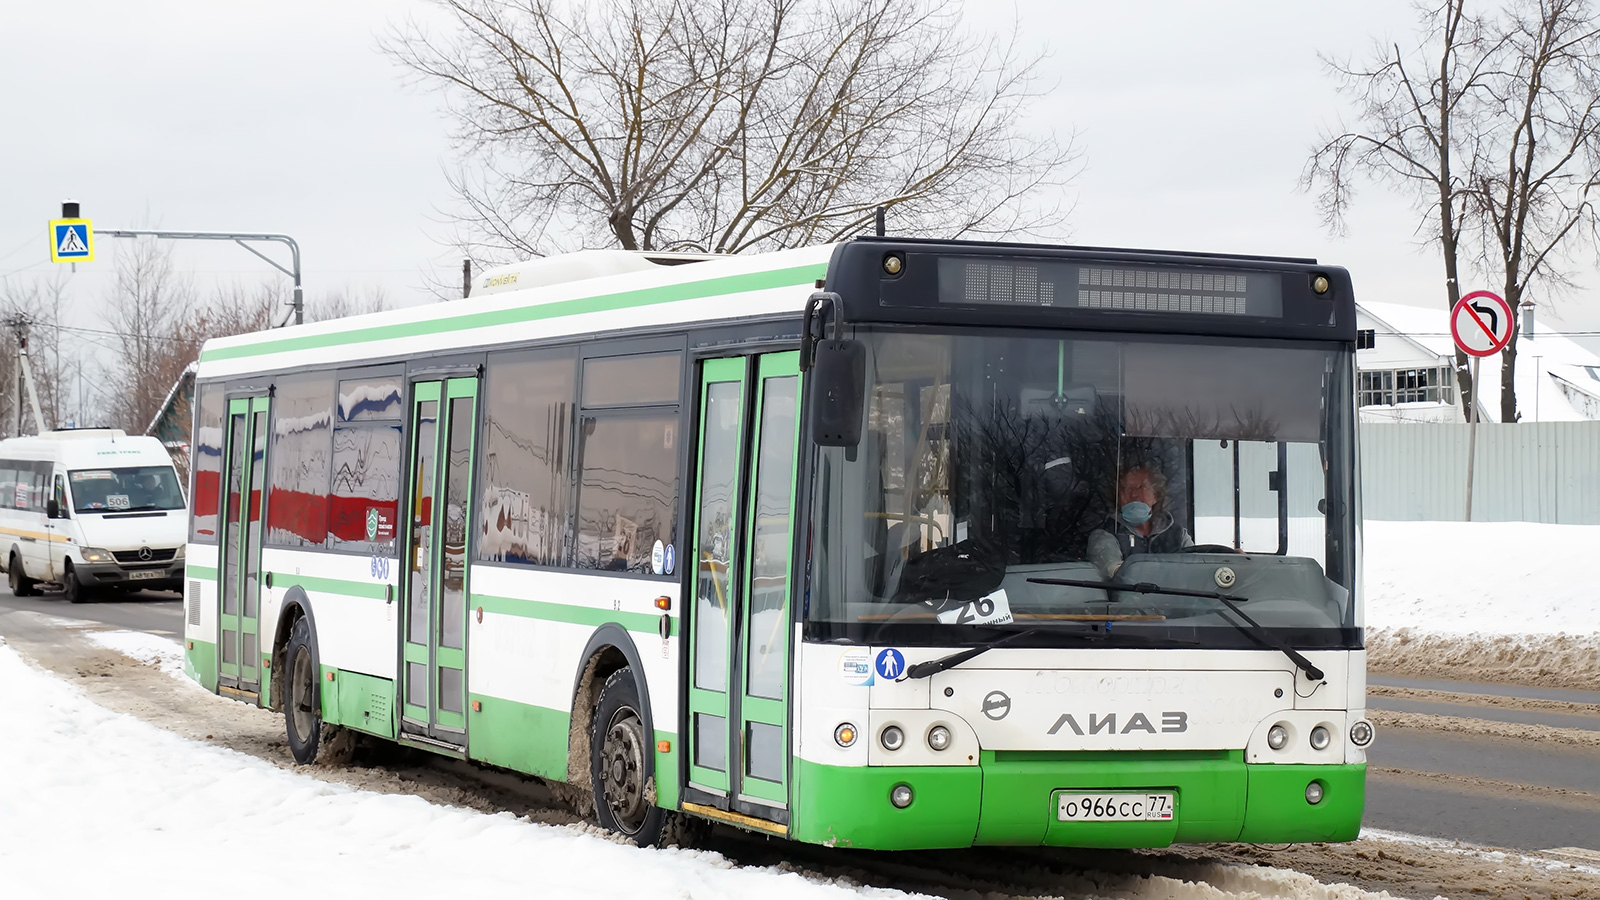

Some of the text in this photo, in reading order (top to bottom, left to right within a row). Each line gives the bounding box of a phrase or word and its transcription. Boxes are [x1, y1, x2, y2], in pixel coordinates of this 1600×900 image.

[109, 497, 129, 506] 506
[957, 598, 995, 625] 26
[1047, 712, 1188, 735] ЛИАЗ
[1149, 796, 1167, 811] 77
